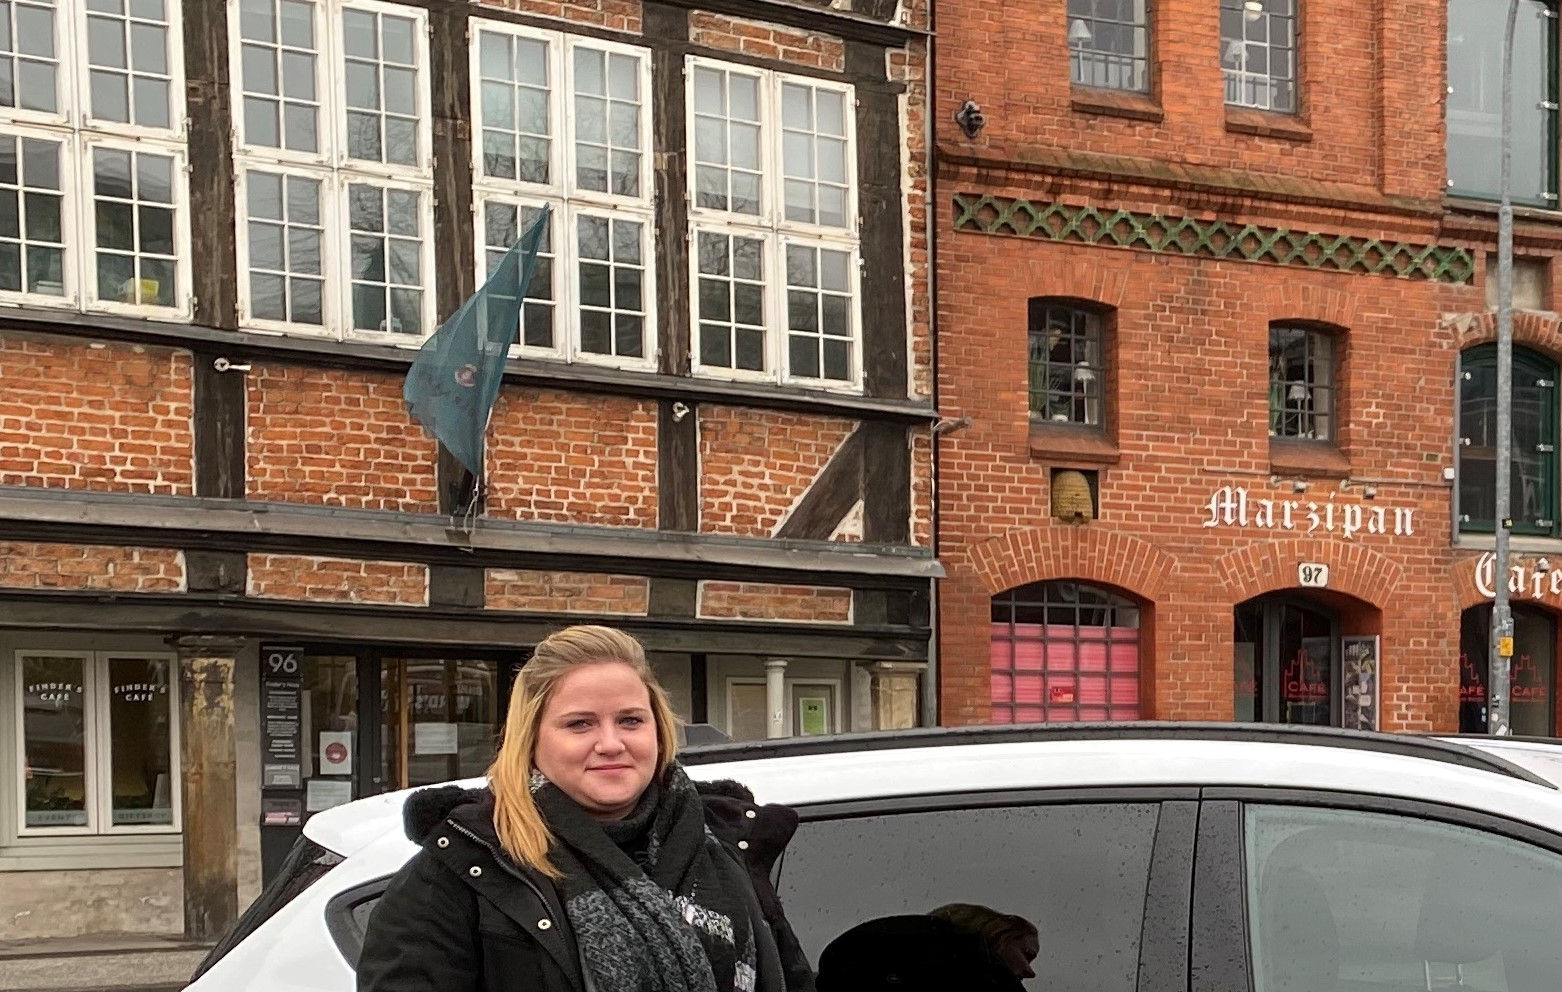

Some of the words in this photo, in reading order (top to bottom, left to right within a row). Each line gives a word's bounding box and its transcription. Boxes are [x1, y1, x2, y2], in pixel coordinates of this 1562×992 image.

[1203, 486, 1414, 539] Marzipan
[1302, 566, 1323, 584] 97
[268, 653, 298, 673] 96
[1459, 684, 1485, 696] AFÉ
